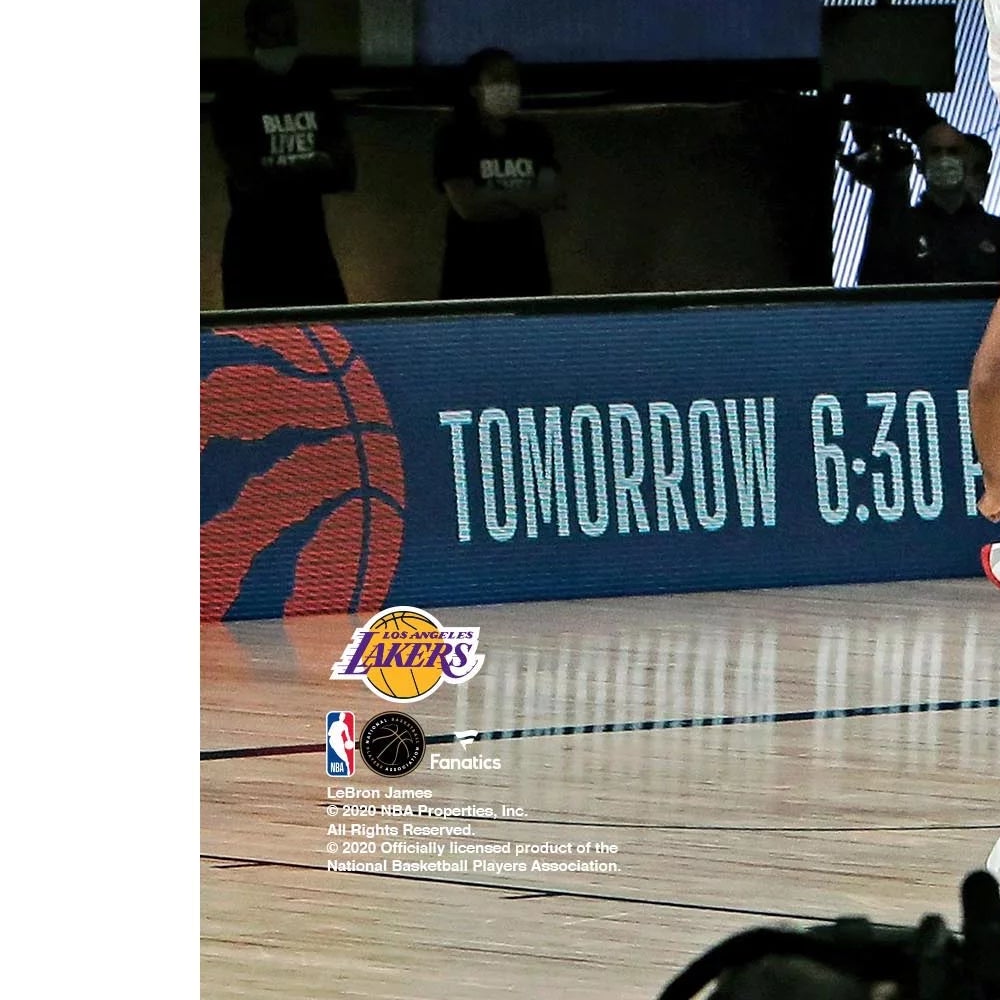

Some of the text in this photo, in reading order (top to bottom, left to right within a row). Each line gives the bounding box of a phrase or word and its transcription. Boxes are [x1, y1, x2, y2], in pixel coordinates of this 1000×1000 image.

[261, 111, 318, 134] BLACK
[439, 396, 776, 543] TOMORROW
[812, 390, 945, 527] 6:30
